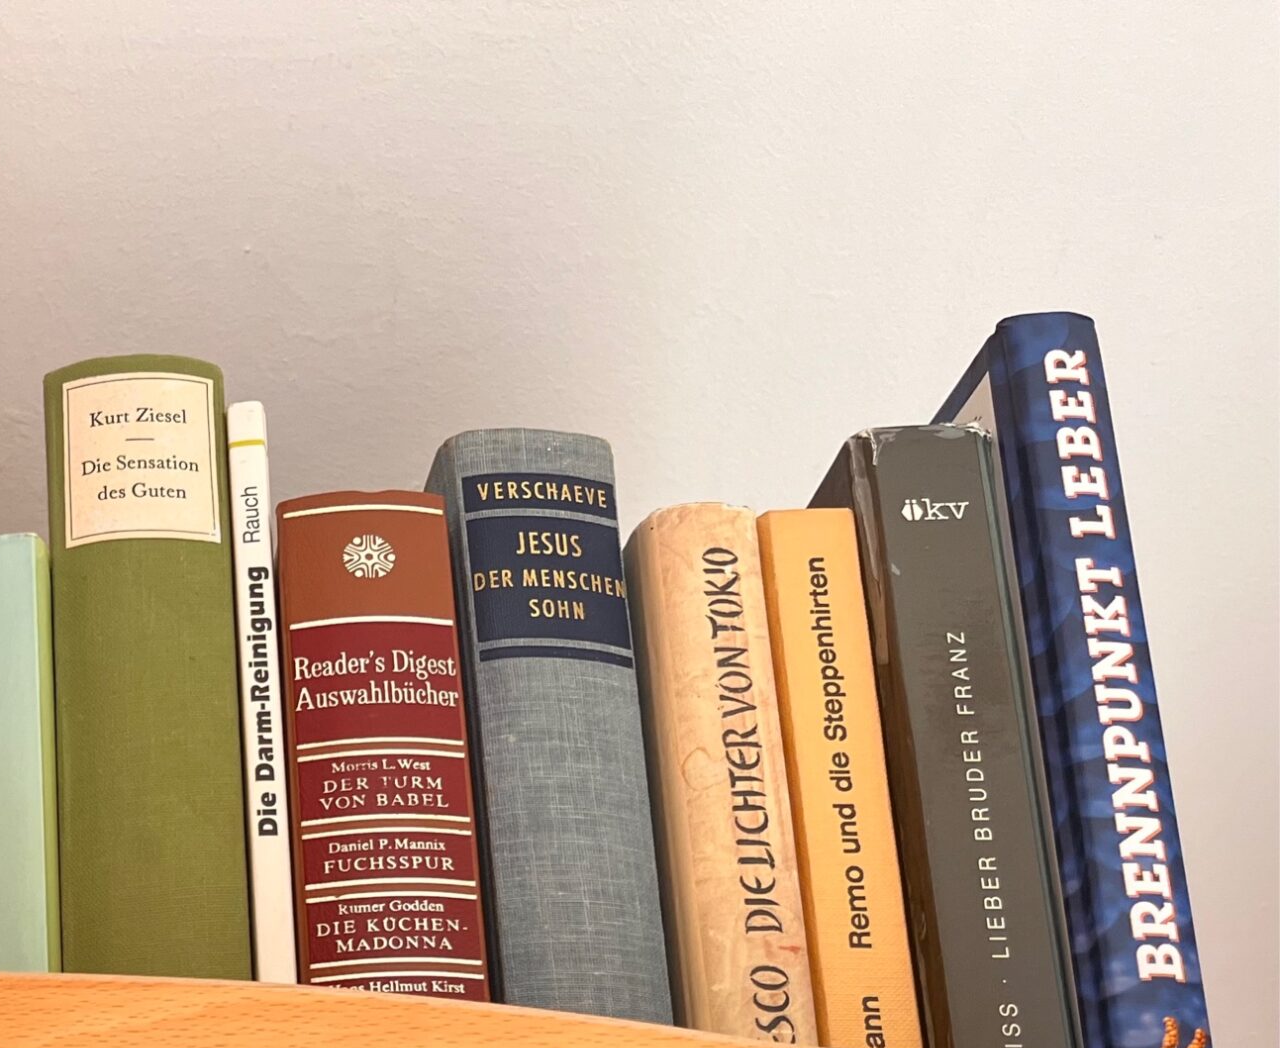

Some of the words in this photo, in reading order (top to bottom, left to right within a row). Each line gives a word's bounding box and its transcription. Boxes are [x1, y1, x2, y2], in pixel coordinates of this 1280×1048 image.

[90, 411, 129, 428] Kurt
[136, 407, 187, 424] Ziesel
[1043, 348, 1115, 540] LEBER
[82, 458, 111, 476] Die
[117, 455, 199, 472] Sensation
[98, 486, 126, 501] des
[132, 483, 186, 499] Guten
[477, 481, 607, 508] VERSCHAEVE
[241, 486, 260, 543] Rauch
[516, 531, 582, 558] JESUS
[473, 569, 514, 592] DER
[523, 569, 626, 599] MENSCHEN
[702, 547, 745, 639] TOKIO
[529, 599, 585, 621] SOHN
[809, 557, 848, 741] Steppenhirten
[247, 566, 276, 782] Darm-Reinigung
[294, 651, 385, 681] Reader's
[392, 650, 456, 680] Digest
[947, 631, 975, 715] FRANZ
[296, 681, 458, 712] Auswahlbücher
[714, 646, 757, 718] VON
[331, 760, 378, 773] Morris
[829, 752, 853, 792] die
[1065, 557, 1186, 984] BRENNPUNKT
[323, 777, 369, 794] DER
[380, 776, 442, 790] TURM
[722, 723, 776, 870] LICHTER
[961, 730, 993, 841] BRUDER
[258, 791, 279, 837] Die
[319, 794, 366, 810] VON
[376, 793, 449, 808] BABEL
[832, 803, 861, 854] und
[328, 839, 373, 854] Daniel
[379, 839, 392, 850] P.
[394, 838, 446, 850] Mannix
[324, 856, 455, 874] FUCHSSPUR
[338, 902, 385, 915] Rumer
[389, 900, 445, 912] Godden
[739, 875, 783, 935] DIE
[845, 865, 872, 948] Remo
[978, 857, 1010, 958] LIEBER
[316, 920, 357, 937] DIE
[367, 917, 468, 932] KÜCHEN-
[336, 936, 453, 953] MADONNA
[369, 980, 427, 993] Hellmut
[432, 980, 465, 994] Kirst
[750, 965, 796, 1044] SCO
